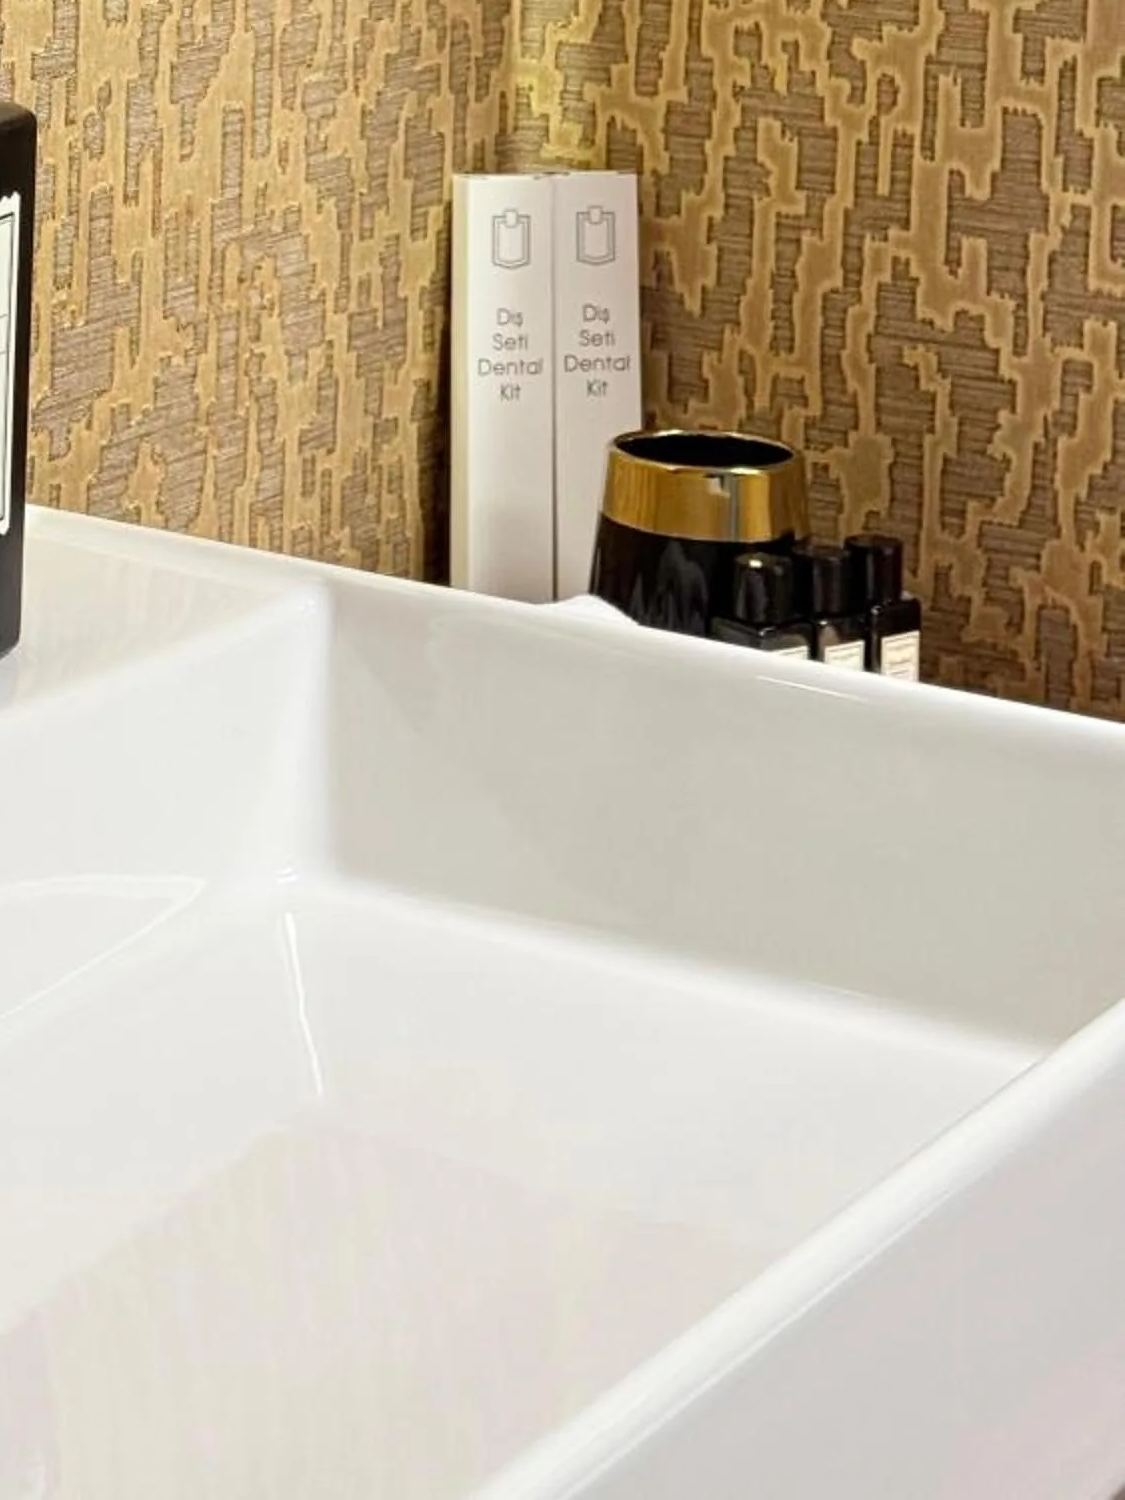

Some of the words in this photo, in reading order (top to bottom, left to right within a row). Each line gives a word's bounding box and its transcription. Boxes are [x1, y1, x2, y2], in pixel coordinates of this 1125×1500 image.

[492, 333, 529, 350] Seti
[579, 329, 616, 347] Seti
[477, 358, 544, 376] Dental
[564, 354, 631, 372] Dental
[500, 384, 521, 401] Kit
[586, 379, 608, 397] Kit
